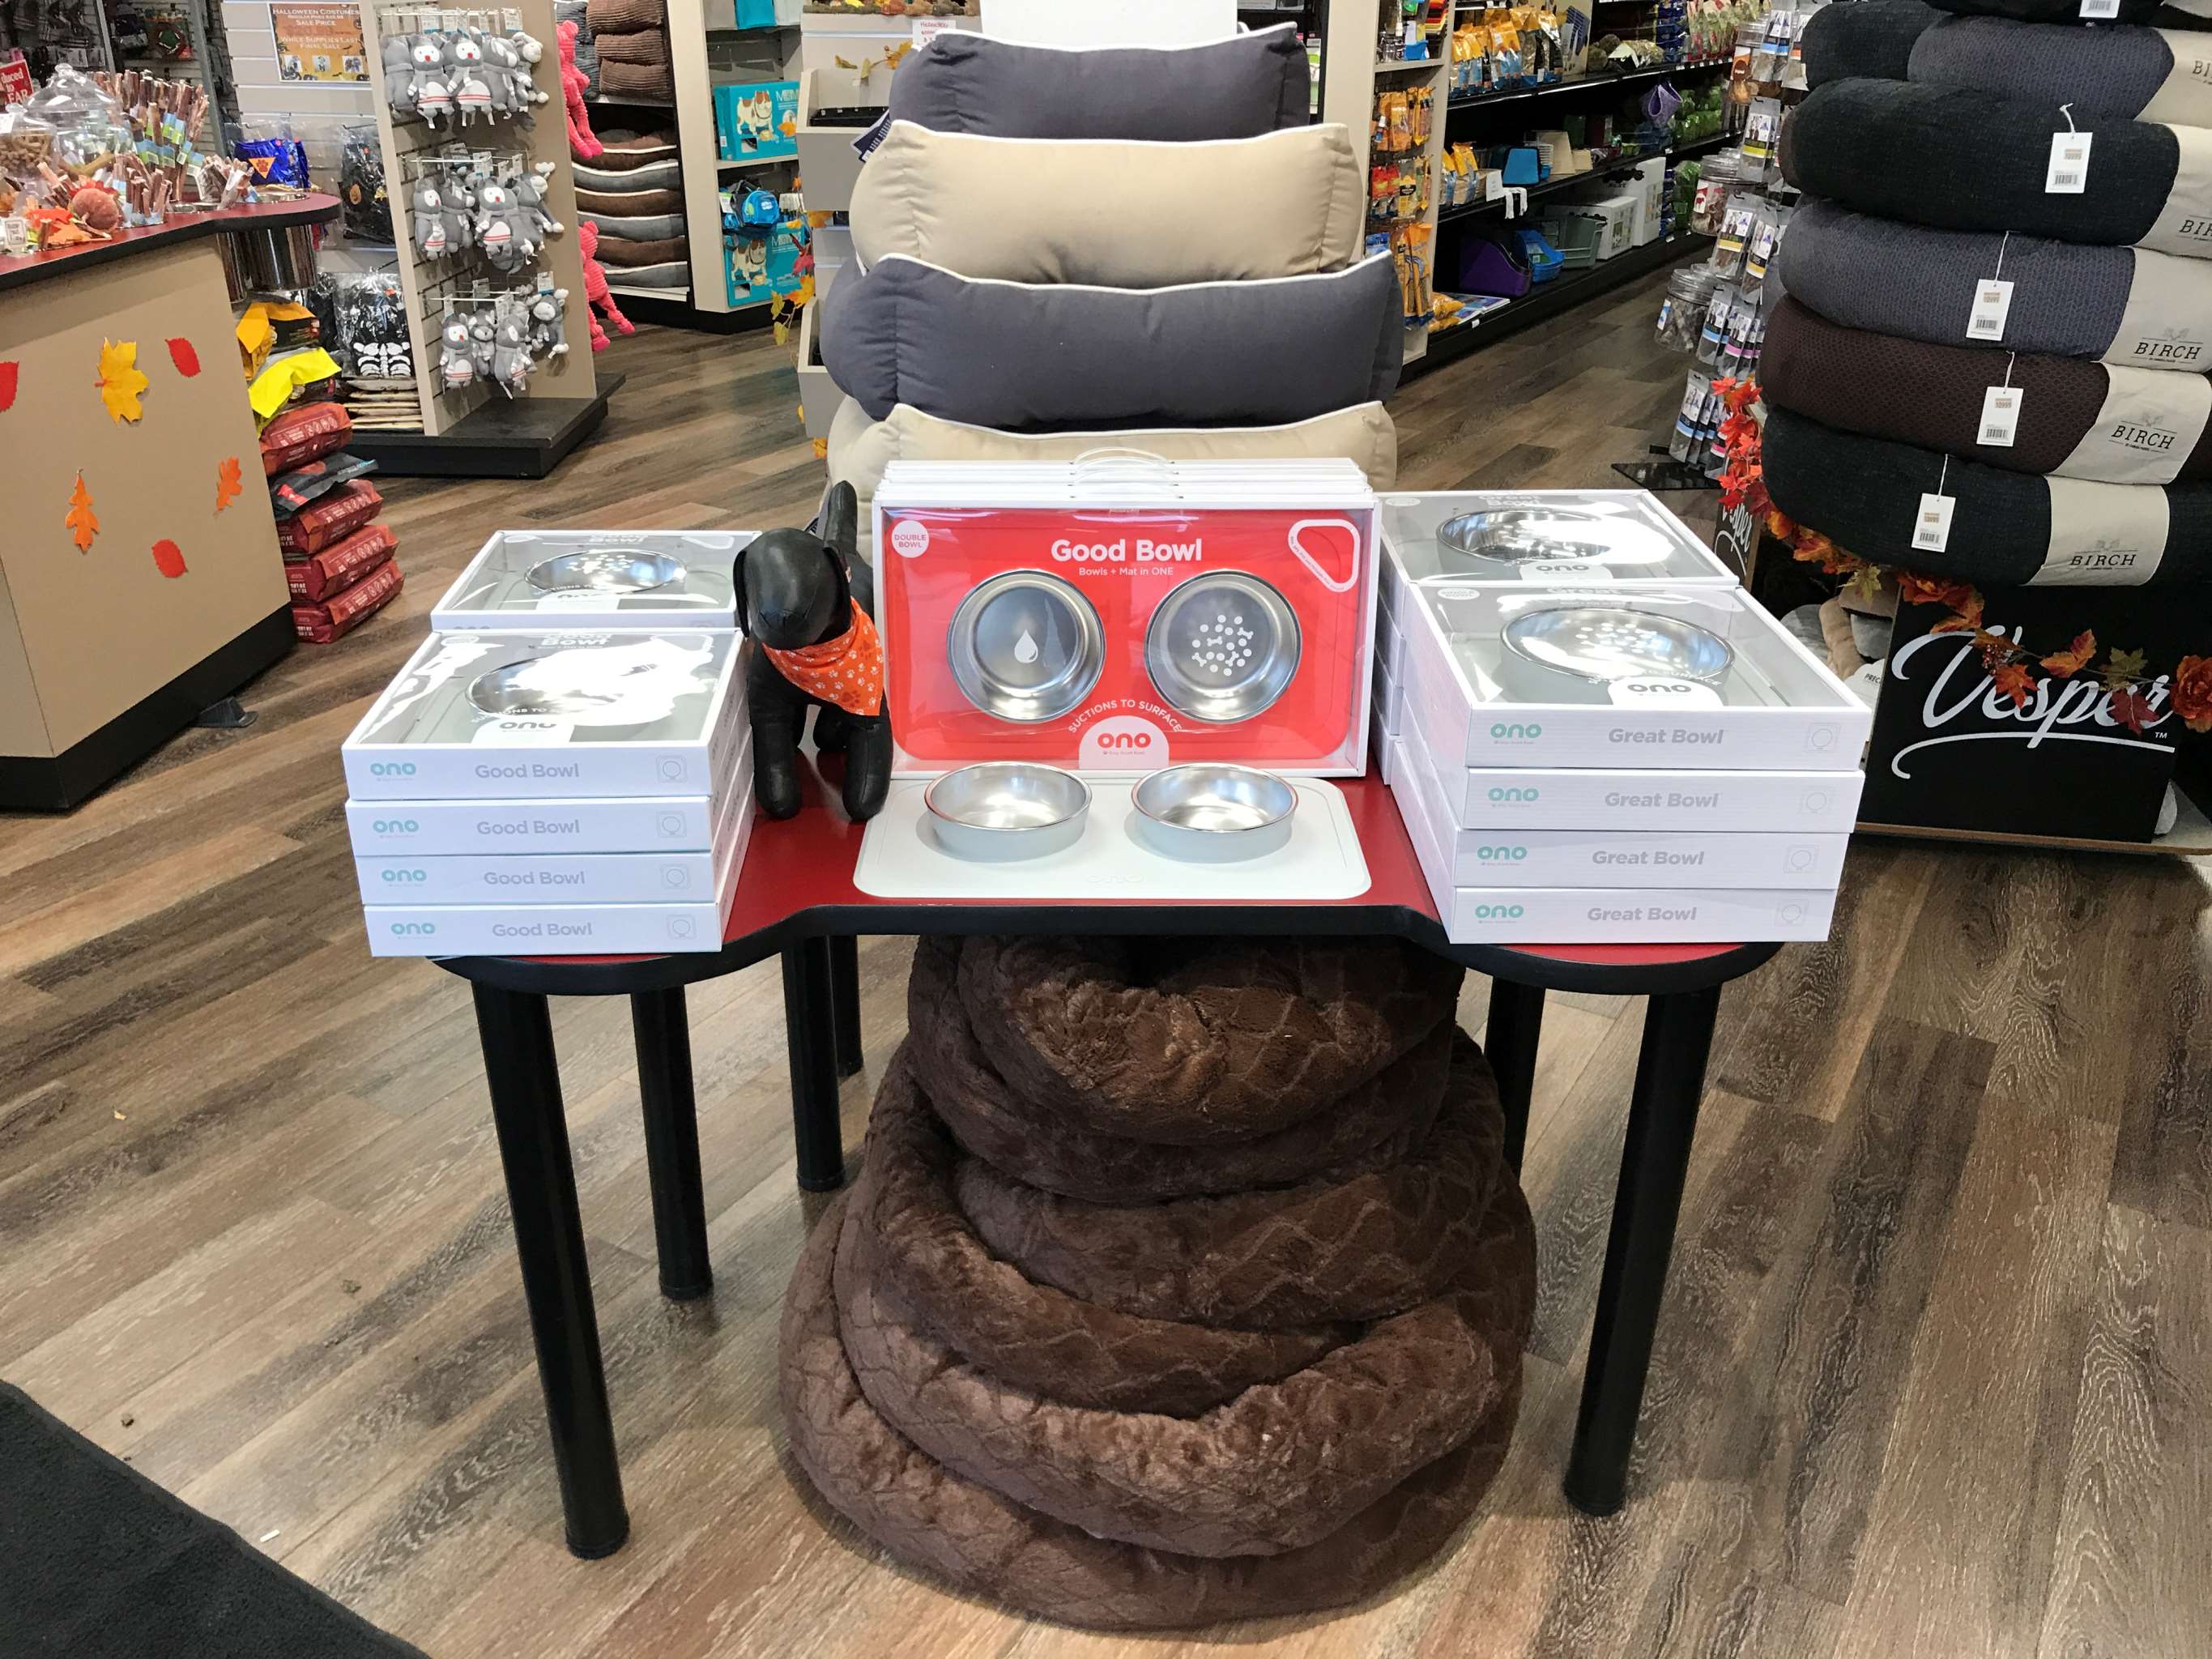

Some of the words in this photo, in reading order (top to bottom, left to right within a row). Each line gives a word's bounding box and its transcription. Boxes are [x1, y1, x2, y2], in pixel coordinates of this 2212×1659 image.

[2133, 342, 2202, 360] BIRCH
[2111, 424, 2176, 450] BIRCH
[1051, 539, 1126, 562] Good
[1136, 538, 1203, 562] Bowl
[2069, 554, 2137, 566] BIRCH
[1079, 567, 1108, 576] Bowls
[1119, 568, 1138, 576] Mat
[1140, 568, 1149, 576] in
[1152, 568, 1174, 576] ONE
[1627, 684, 1692, 693] ono
[1068, 699, 1117, 733] SUCTIONS
[1121, 699, 1136, 708] TO
[1138, 701, 1183, 732] SURFACE
[1097, 732, 1151, 748] ono
[1490, 723, 1542, 739] ono
[1609, 728, 1665, 744] Great
[1672, 729, 1724, 744] Bowl
[370, 762, 416, 776] ono
[475, 765, 528, 778] Good
[533, 763, 580, 778] Bowl
[1488, 787, 1539, 802] ono
[1605, 792, 1661, 808] Great
[1667, 792, 1719, 808] Bowl
[373, 820, 419, 834] ono
[476, 821, 529, 835] Good
[534, 819, 580, 834] Bowl
[1477, 846, 1528, 860] ono
[1592, 851, 1648, 865] Great
[1653, 851, 1704, 866] Bowl
[381, 869, 427, 882] ono
[484, 871, 535, 885] Good
[539, 871, 586, 885] Bowl
[1475, 905, 1524, 919] ono
[1588, 907, 1643, 922] Great
[1647, 907, 1698, 922] Bowl
[391, 922, 436, 935] ono
[492, 923, 543, 937] Good
[547, 923, 593, 936] Bowl
